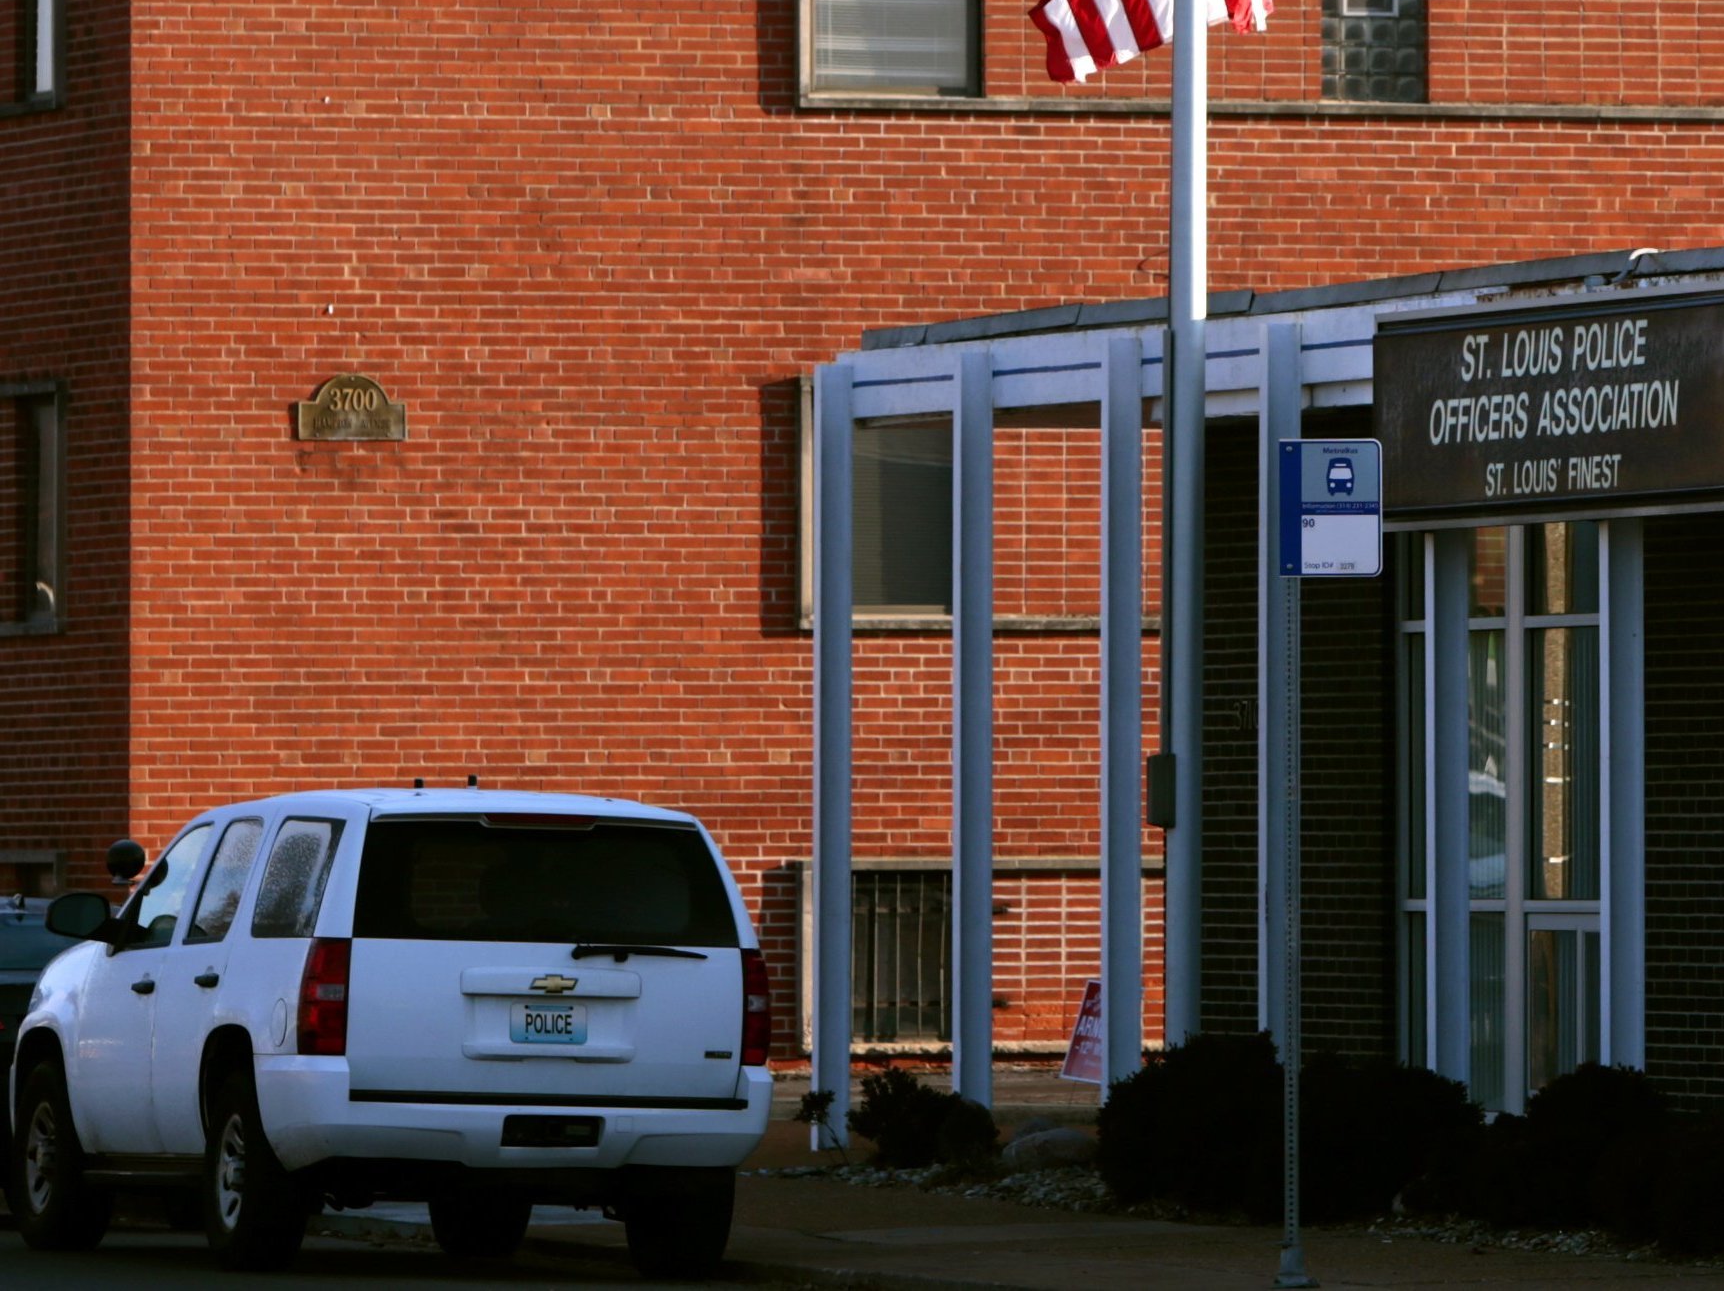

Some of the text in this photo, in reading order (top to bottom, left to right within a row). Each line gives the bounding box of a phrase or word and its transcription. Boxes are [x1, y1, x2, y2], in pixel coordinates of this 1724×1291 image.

[1461, 318, 1648, 383] ST. LOUIS POLICE
[329, 388, 378, 411] 3700
[1429, 379, 1680, 446] OFFICERS ASSOCIATION
[1485, 462, 1507, 497] ST.
[1567, 454, 1622, 491] FINEST
[1302, 518, 1316, 528] 90
[1304, 562, 1320, 570] Stop
[525, 1013, 573, 1035] POLICE
